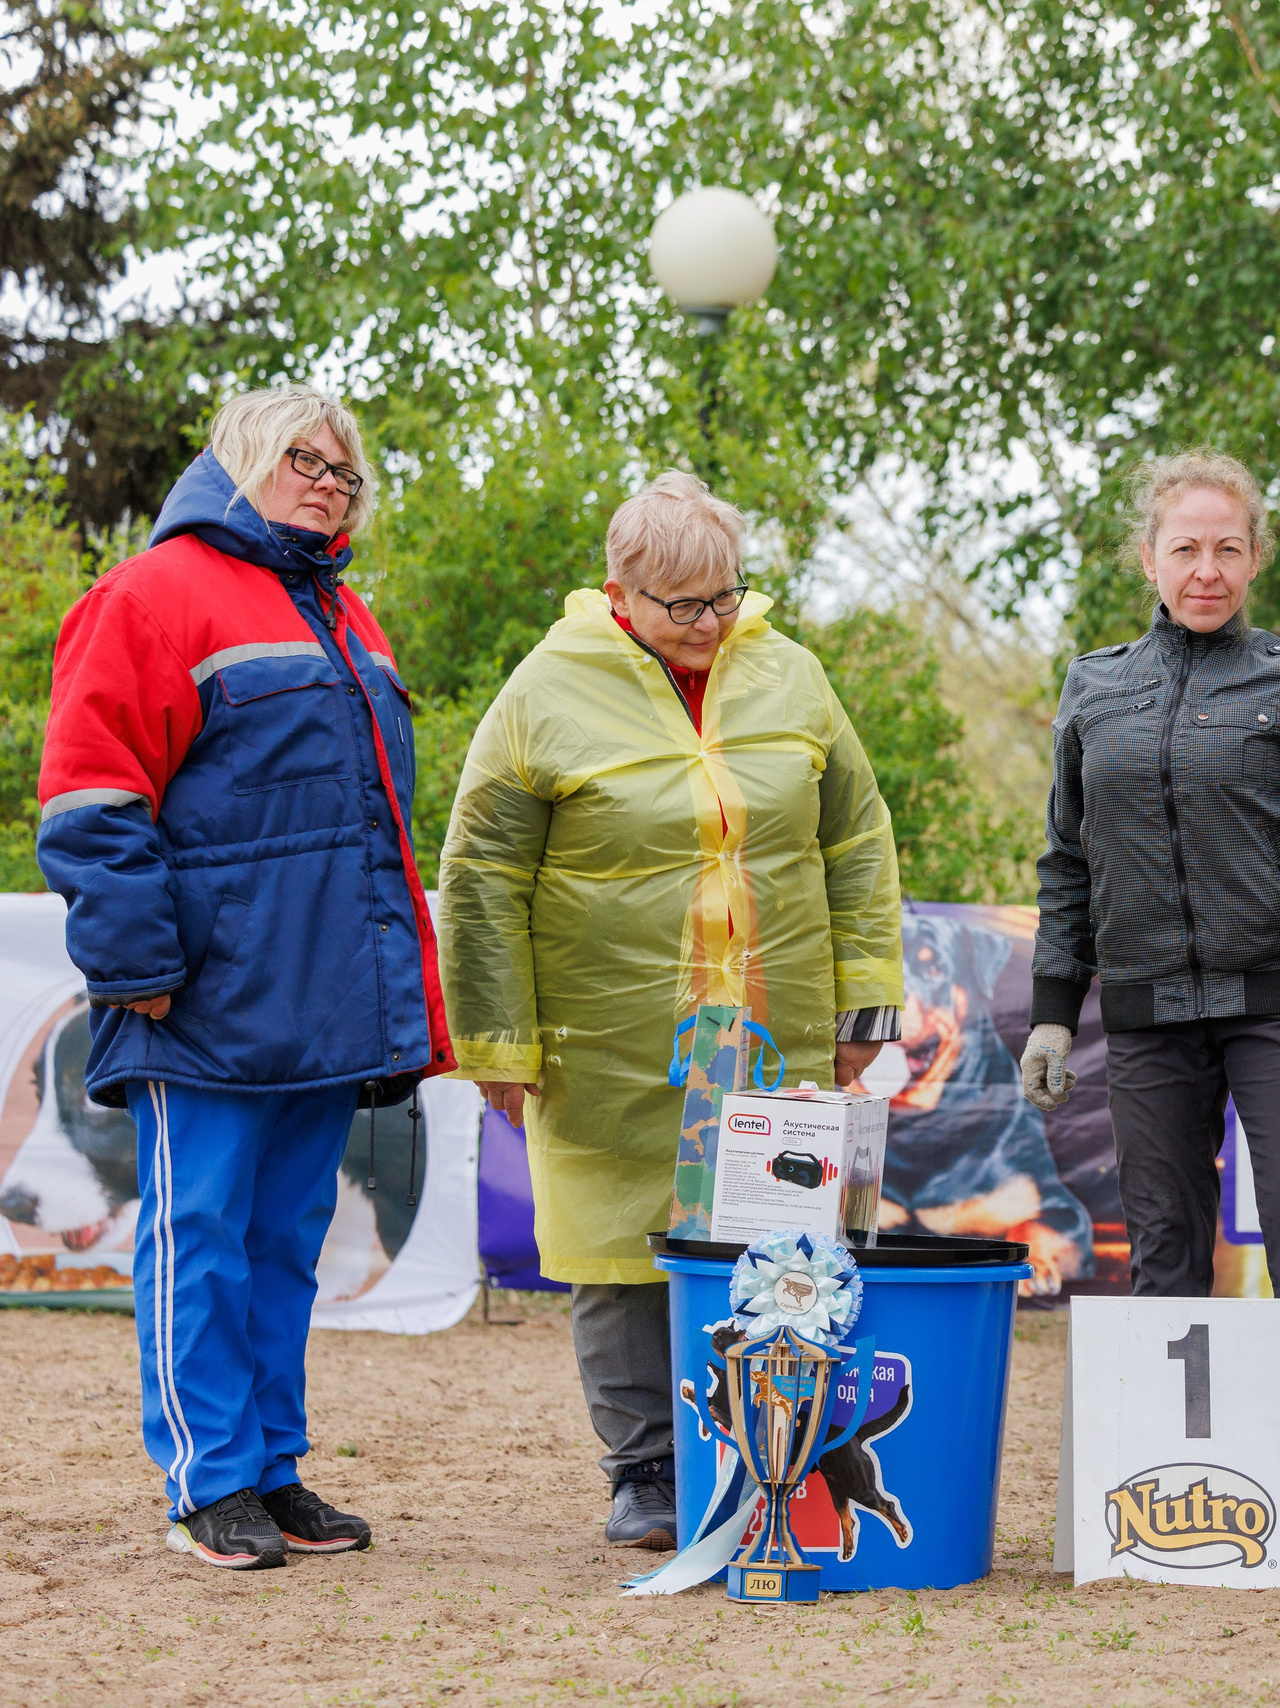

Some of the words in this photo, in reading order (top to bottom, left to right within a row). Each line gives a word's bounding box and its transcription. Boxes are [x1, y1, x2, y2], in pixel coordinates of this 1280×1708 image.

[734, 1118, 765, 1130] lentel
[783, 1119, 840, 1132] Акустическая
[782, 1128, 816, 1138] система
[1167, 1324, 1212, 1439] 1
[1107, 1480, 1268, 1566] Nutro
[750, 1578, 777, 1591] ЛЮ
